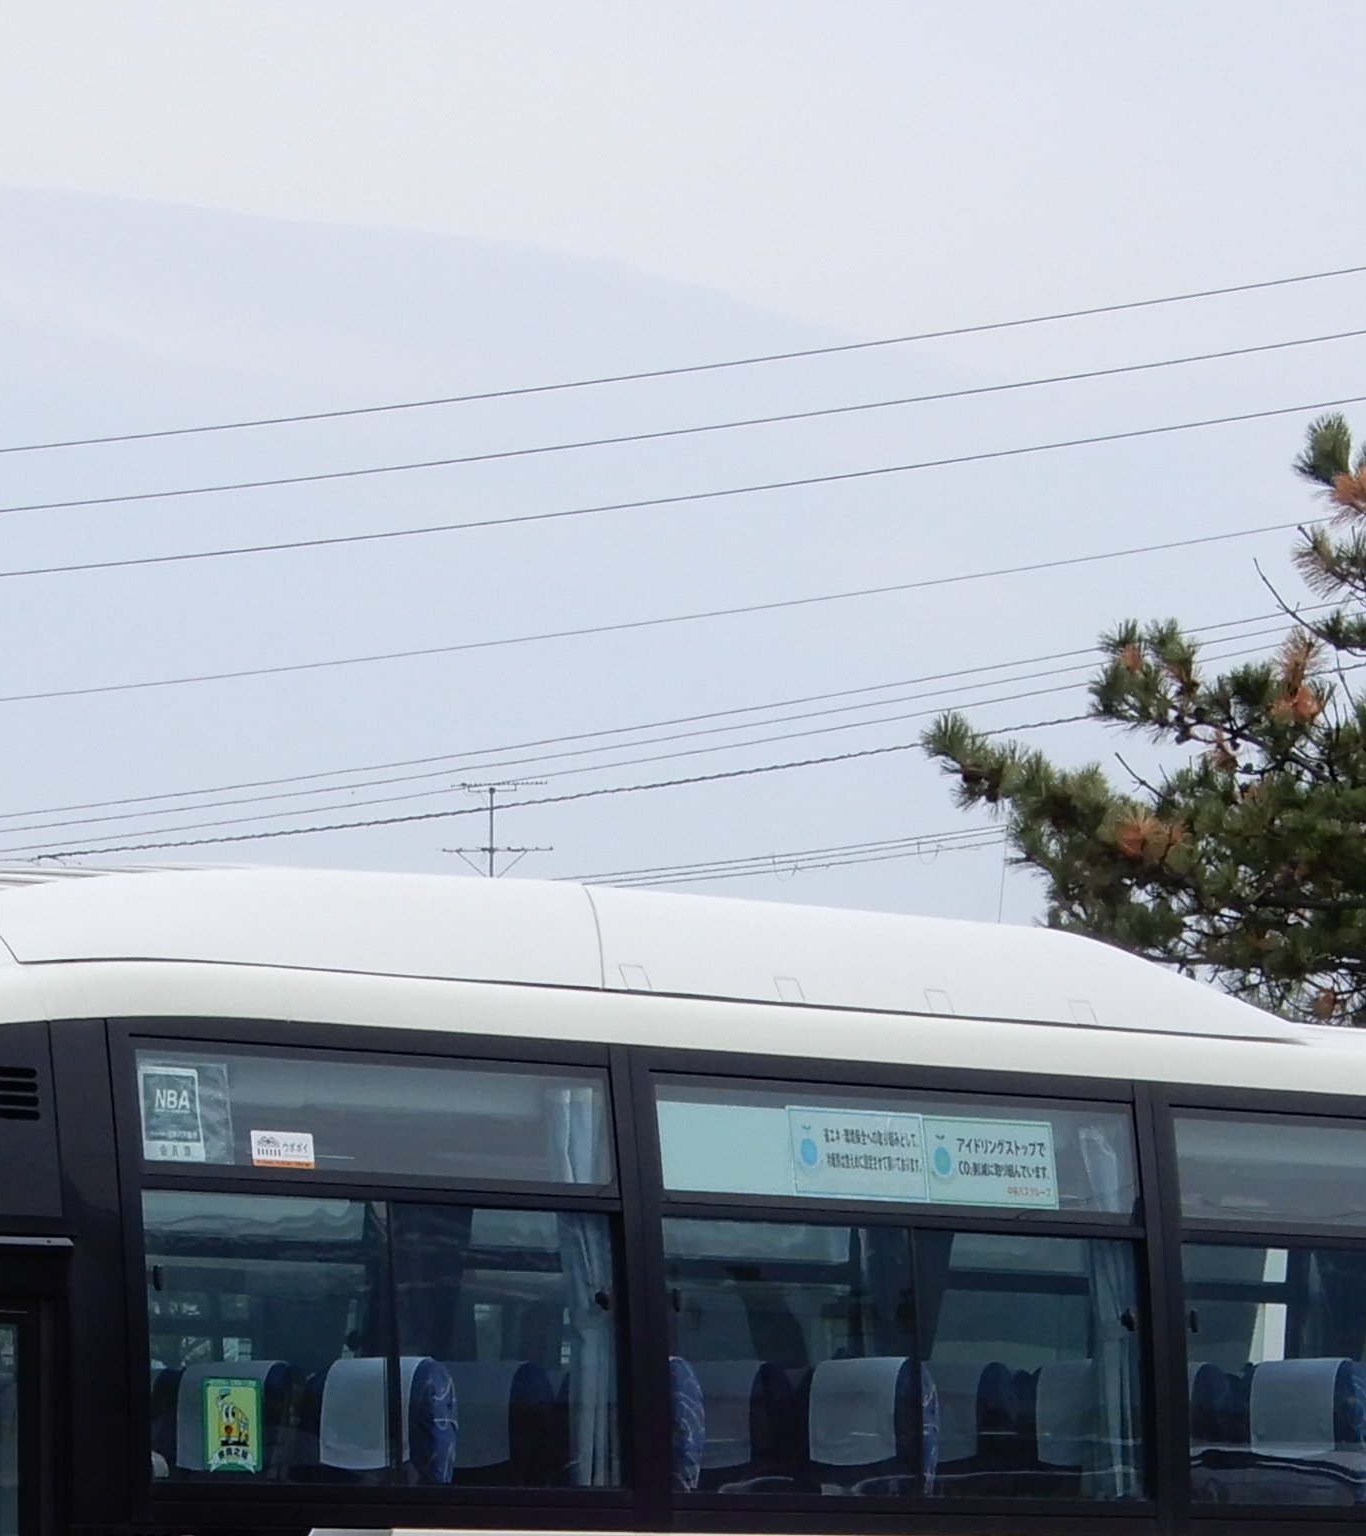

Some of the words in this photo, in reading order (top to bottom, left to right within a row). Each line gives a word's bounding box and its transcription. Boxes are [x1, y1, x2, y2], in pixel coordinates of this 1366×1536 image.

[155, 1088, 191, 1110] NBA
[956, 1137, 1047, 1158] アイドリングストップで
